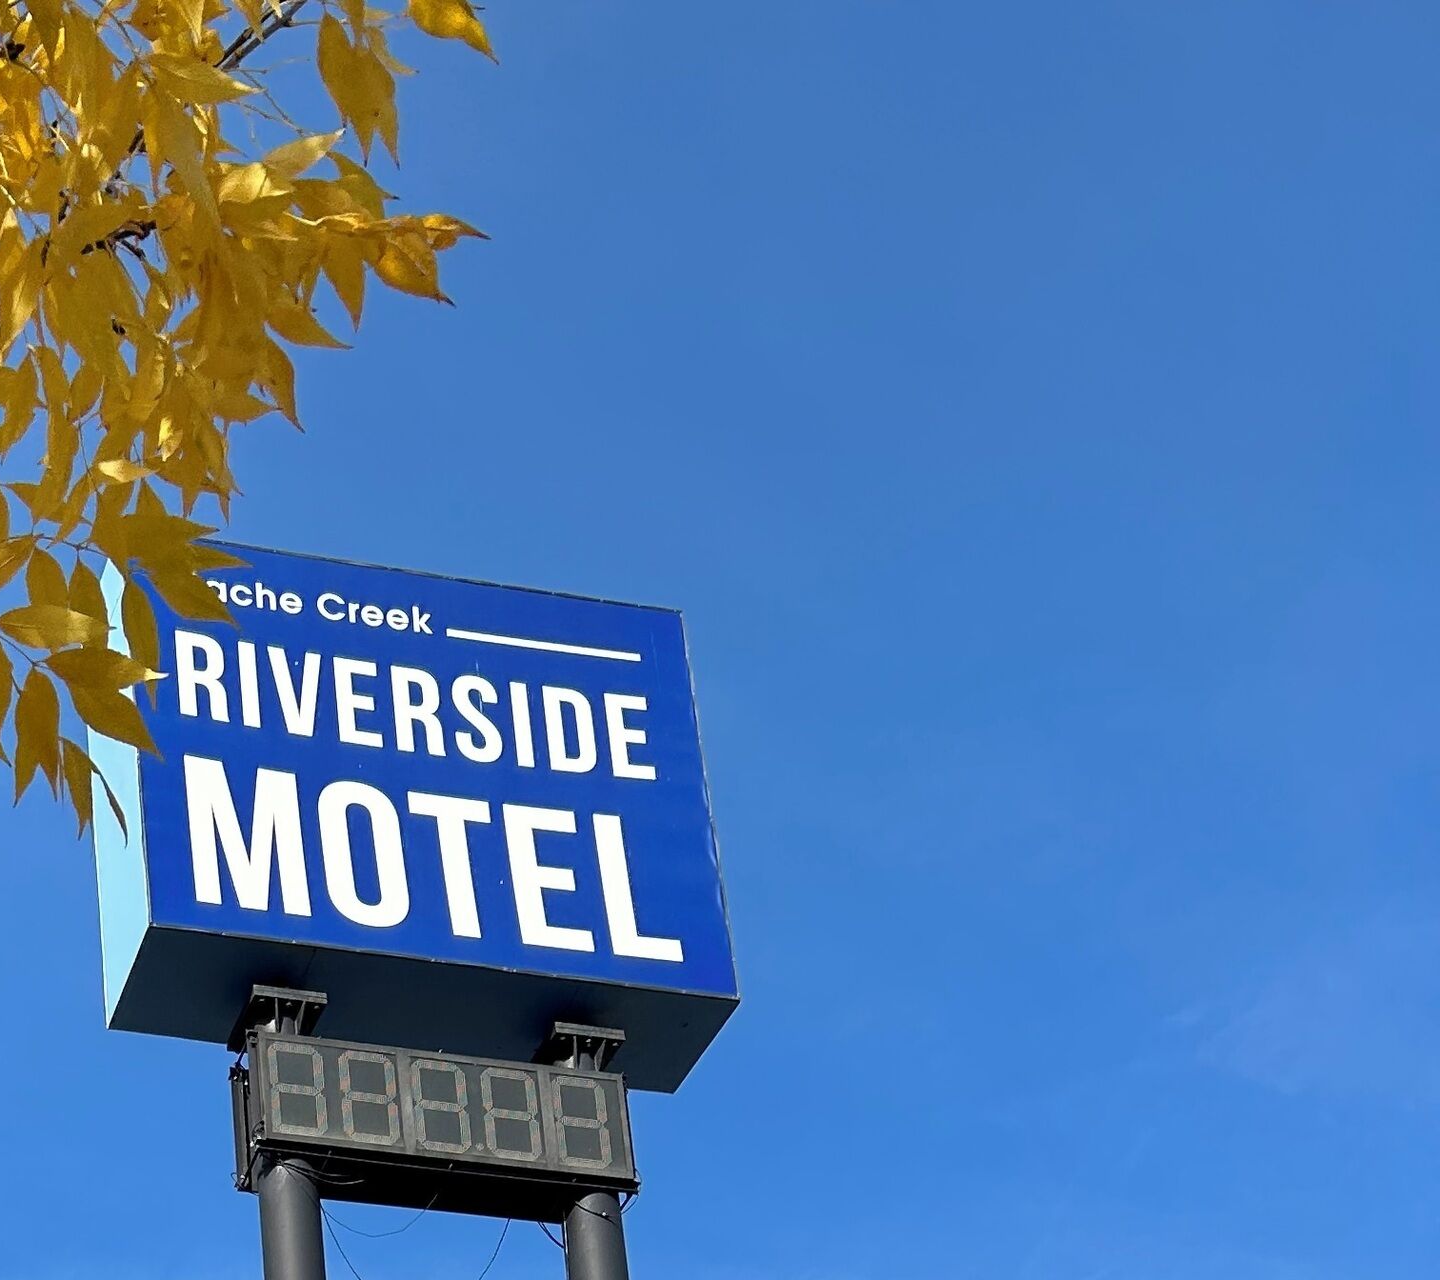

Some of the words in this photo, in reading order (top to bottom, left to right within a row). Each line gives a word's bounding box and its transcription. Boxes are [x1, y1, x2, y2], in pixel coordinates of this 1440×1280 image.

[206, 580, 303, 614] ache
[317, 592, 433, 635] Creek
[174, 629, 657, 781] RIVERSIDE
[183, 754, 684, 963] MOTEL
